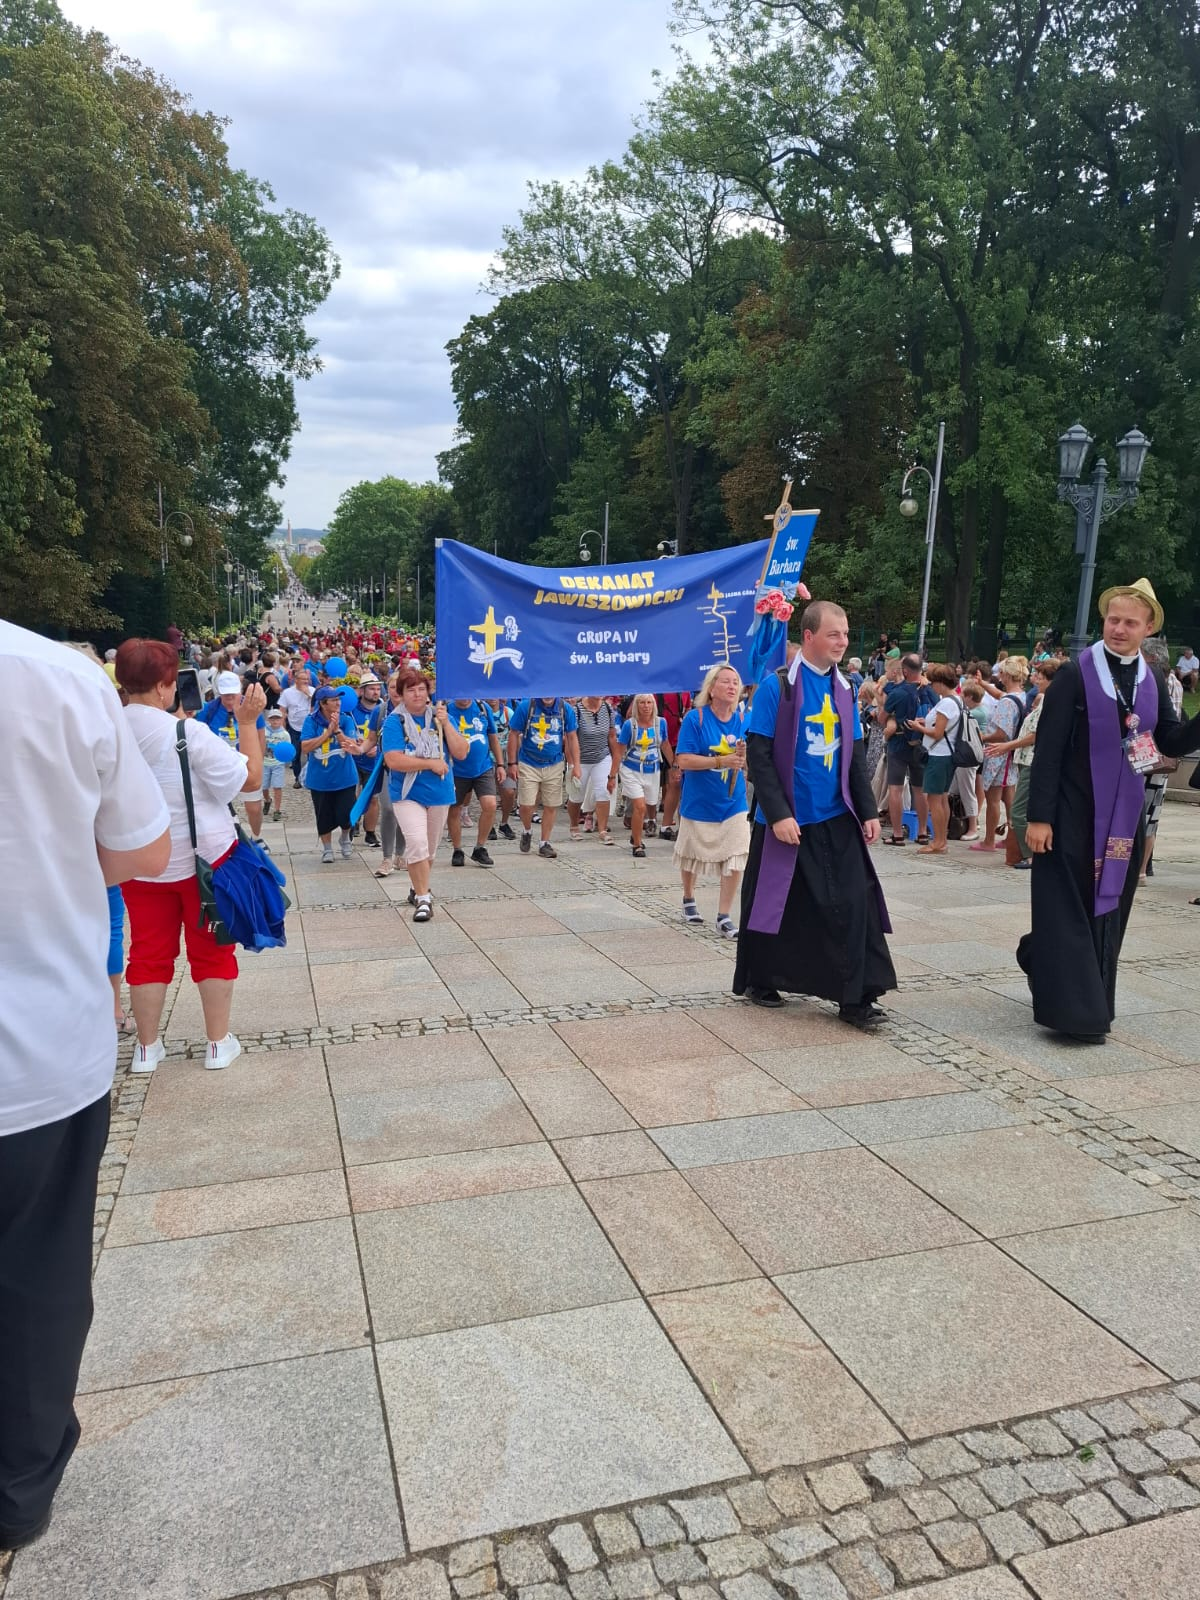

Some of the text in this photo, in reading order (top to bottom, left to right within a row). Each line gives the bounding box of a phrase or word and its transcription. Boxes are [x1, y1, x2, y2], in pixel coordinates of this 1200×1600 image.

[784, 536, 799, 551] św.
[768, 557, 801, 576] Barbara
[559, 571, 655, 591] DEKANAT
[533, 588, 685, 611] JAWISZOWICKI
[577, 629, 638, 644] GRUPA IV
[569, 650, 650, 665] św. Barbary
